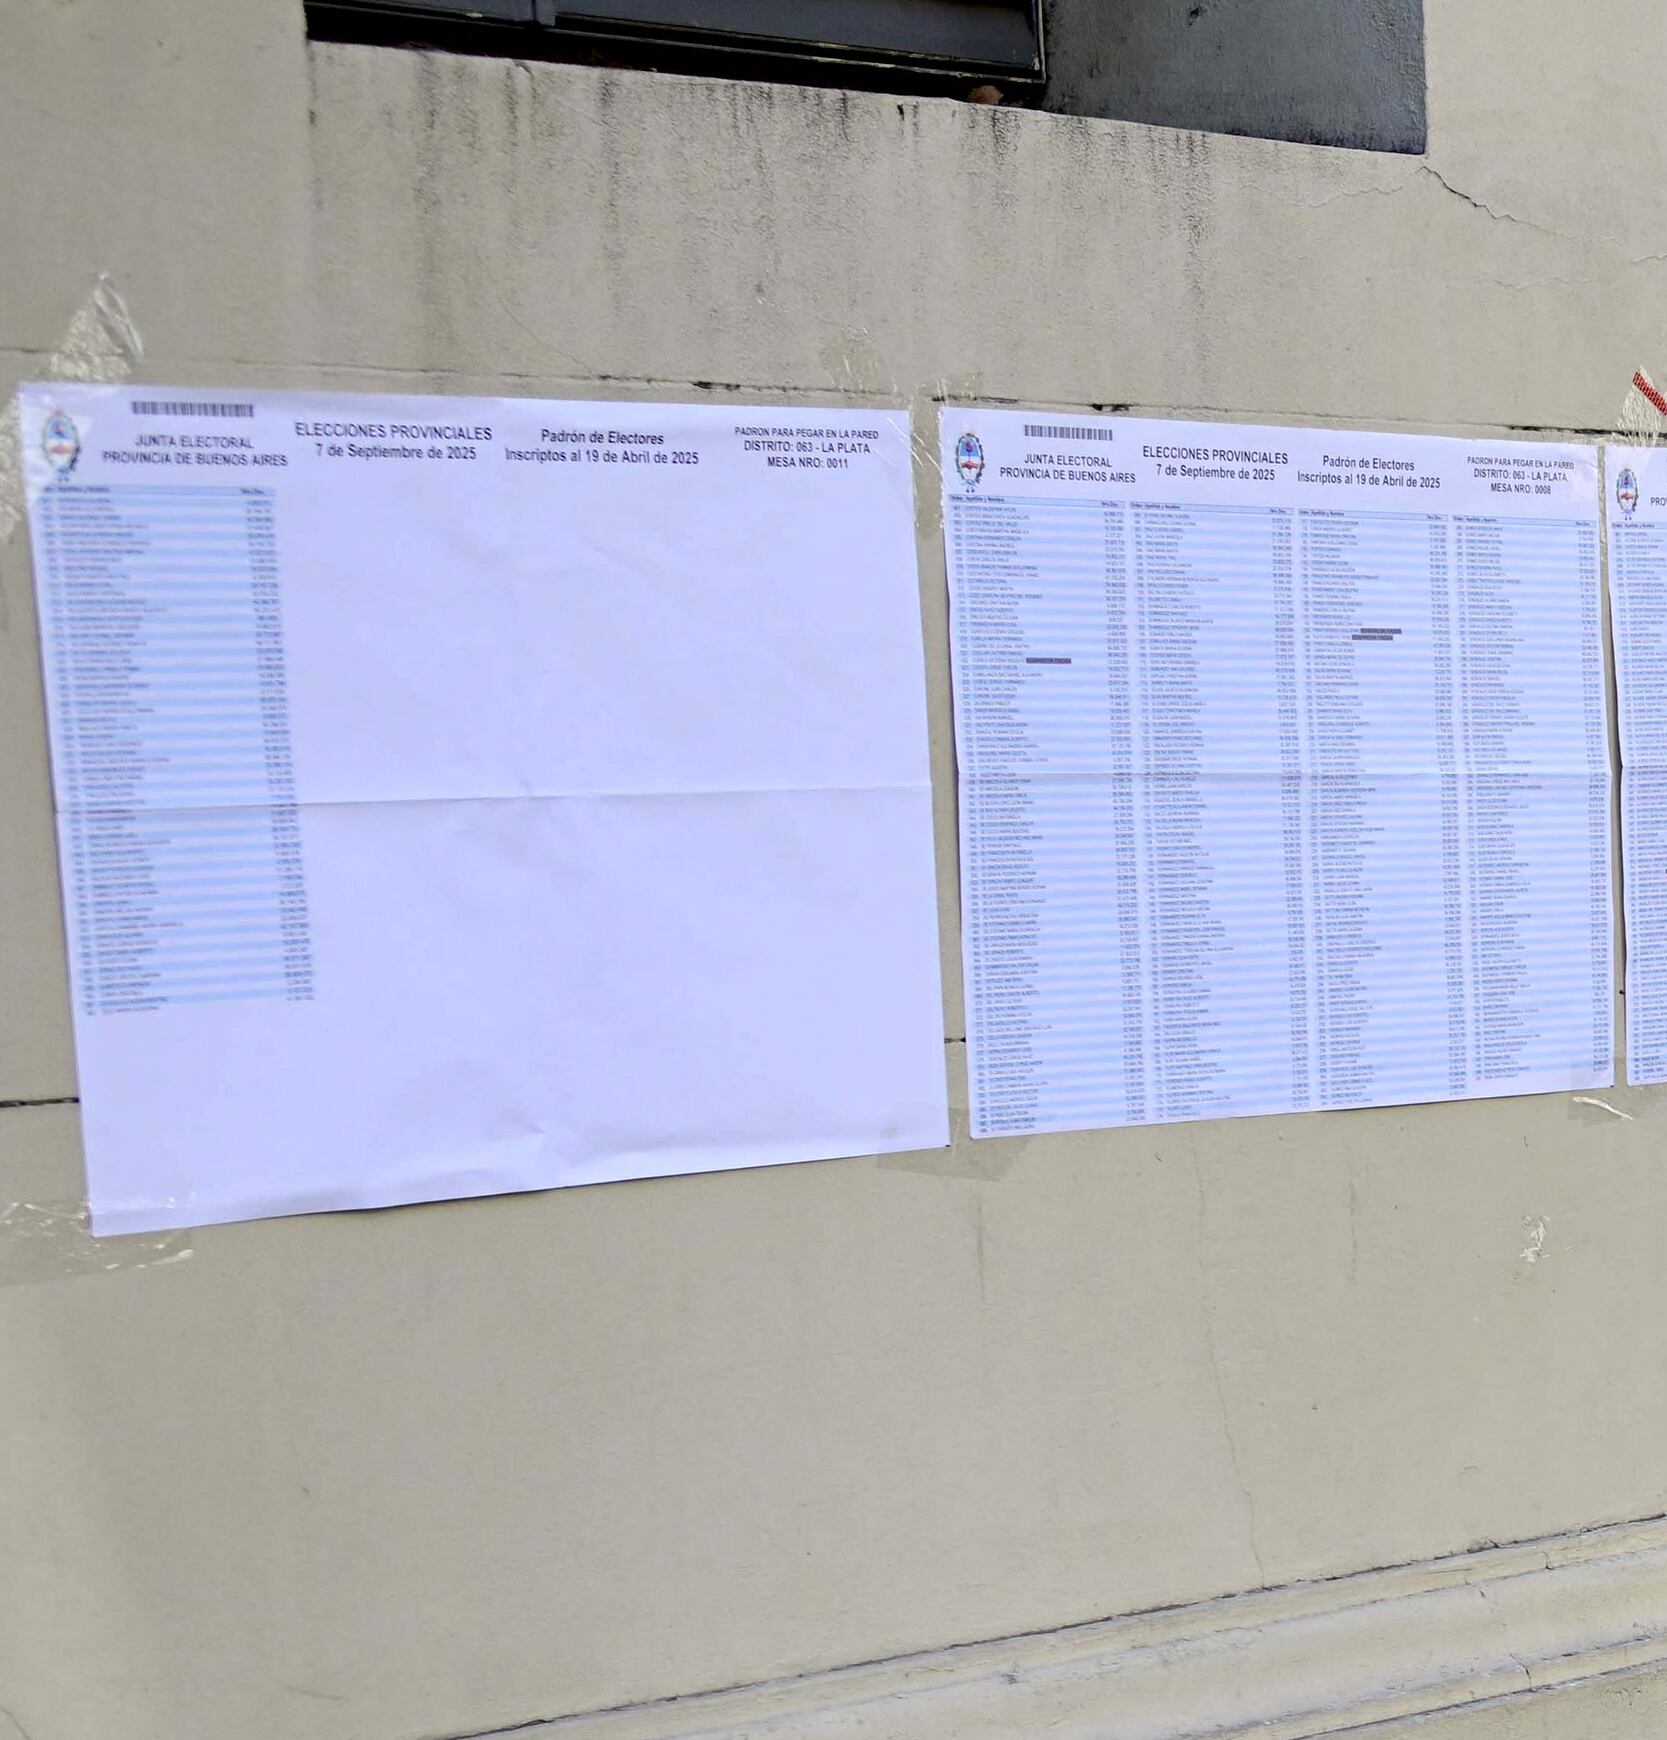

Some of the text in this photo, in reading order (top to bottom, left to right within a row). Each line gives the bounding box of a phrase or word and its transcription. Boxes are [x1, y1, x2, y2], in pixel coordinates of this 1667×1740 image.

[295, 422, 492, 441] ELECCIONES PROVINCIALES
[541, 429, 664, 445] Padrón de Electores
[735, 427, 879, 440] PADRON PARA PEGAR EN LA PARED
[135, 434, 254, 449] JUNTA ELECTORAL
[744, 440, 793, 452] DISTRITO:
[796, 442, 813, 452] 063
[822, 442, 836, 453] LA
[838, 443, 871, 454] PLATA
[102, 451, 288, 467] PROVINCIA DE BUENOS AIRES
[316, 443, 477, 460] 7 de Septiembre de 2025
[505, 448, 699, 465] Inscriptos al 19 de Abril de 2025
[1142, 445, 1288, 464] ELECCIONES PROVINCIALES
[767, 456, 849, 469] MESA NRO: 0011
[1024, 454, 1112, 467] JUNTA ELECTORAL
[1322, 455, 1415, 471] Padrón de Electores
[1467, 456, 1574, 469] PADRON PARA PEGAR EN LA PARED
[1000, 467, 1136, 483] PROVINCIA DE BUENOS AIRES
[1156, 463, 1275, 480] 7 de Septiembre de 2025
[1297, 470, 1441, 488] Inscriptos al 19 de Abril de 2025
[1474, 468, 1511, 479] DISTRITO:
[1513, 470, 1525, 480] 063
[1531, 471, 1541, 481] LA
[1543, 472, 1568, 482] PLATA
[1491, 482, 1551, 495] MESA NRO: 0008
